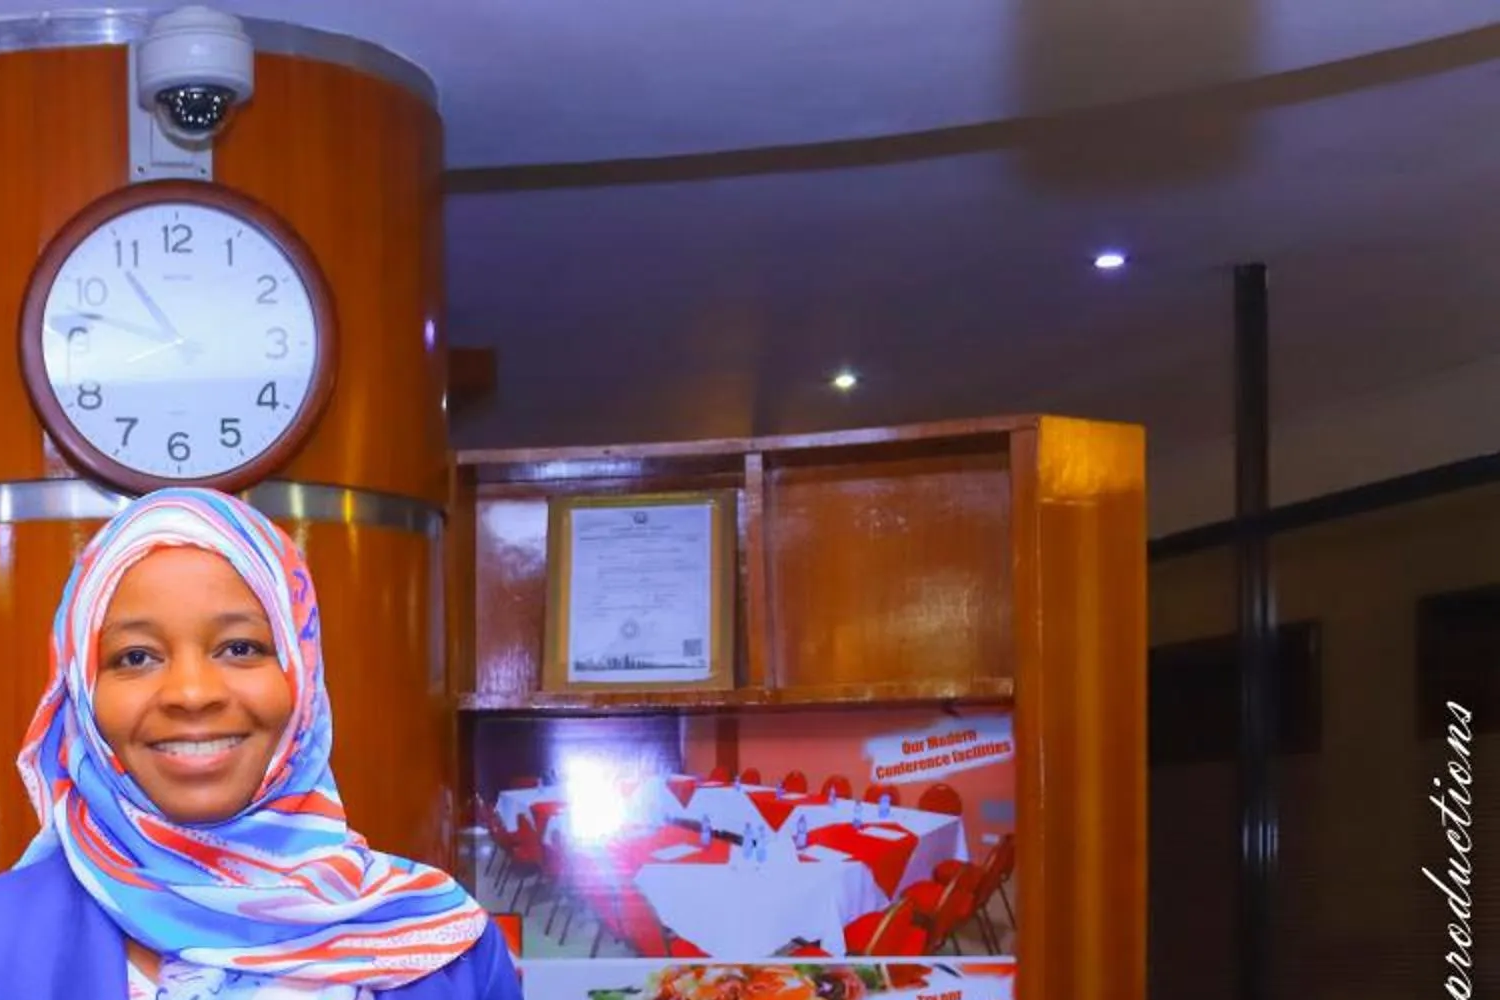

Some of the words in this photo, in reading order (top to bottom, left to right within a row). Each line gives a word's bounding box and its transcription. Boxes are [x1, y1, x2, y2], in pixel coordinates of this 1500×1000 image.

[162, 224, 193, 253] 12
[225, 238, 234, 267] 1
[115, 240, 139, 268] 11
[76, 277, 108, 307] 10
[256, 275, 279, 305] 2
[265, 327, 289, 360] 3
[77, 381, 103, 410] 8
[256, 381, 280, 411] 4
[115, 418, 139, 447] 7
[167, 432, 191, 461] 6
[219, 418, 242, 448] 5
[902, 738, 924, 755] Our
[927, 729, 978, 750] Modern
[876, 753, 950, 779] Conference
